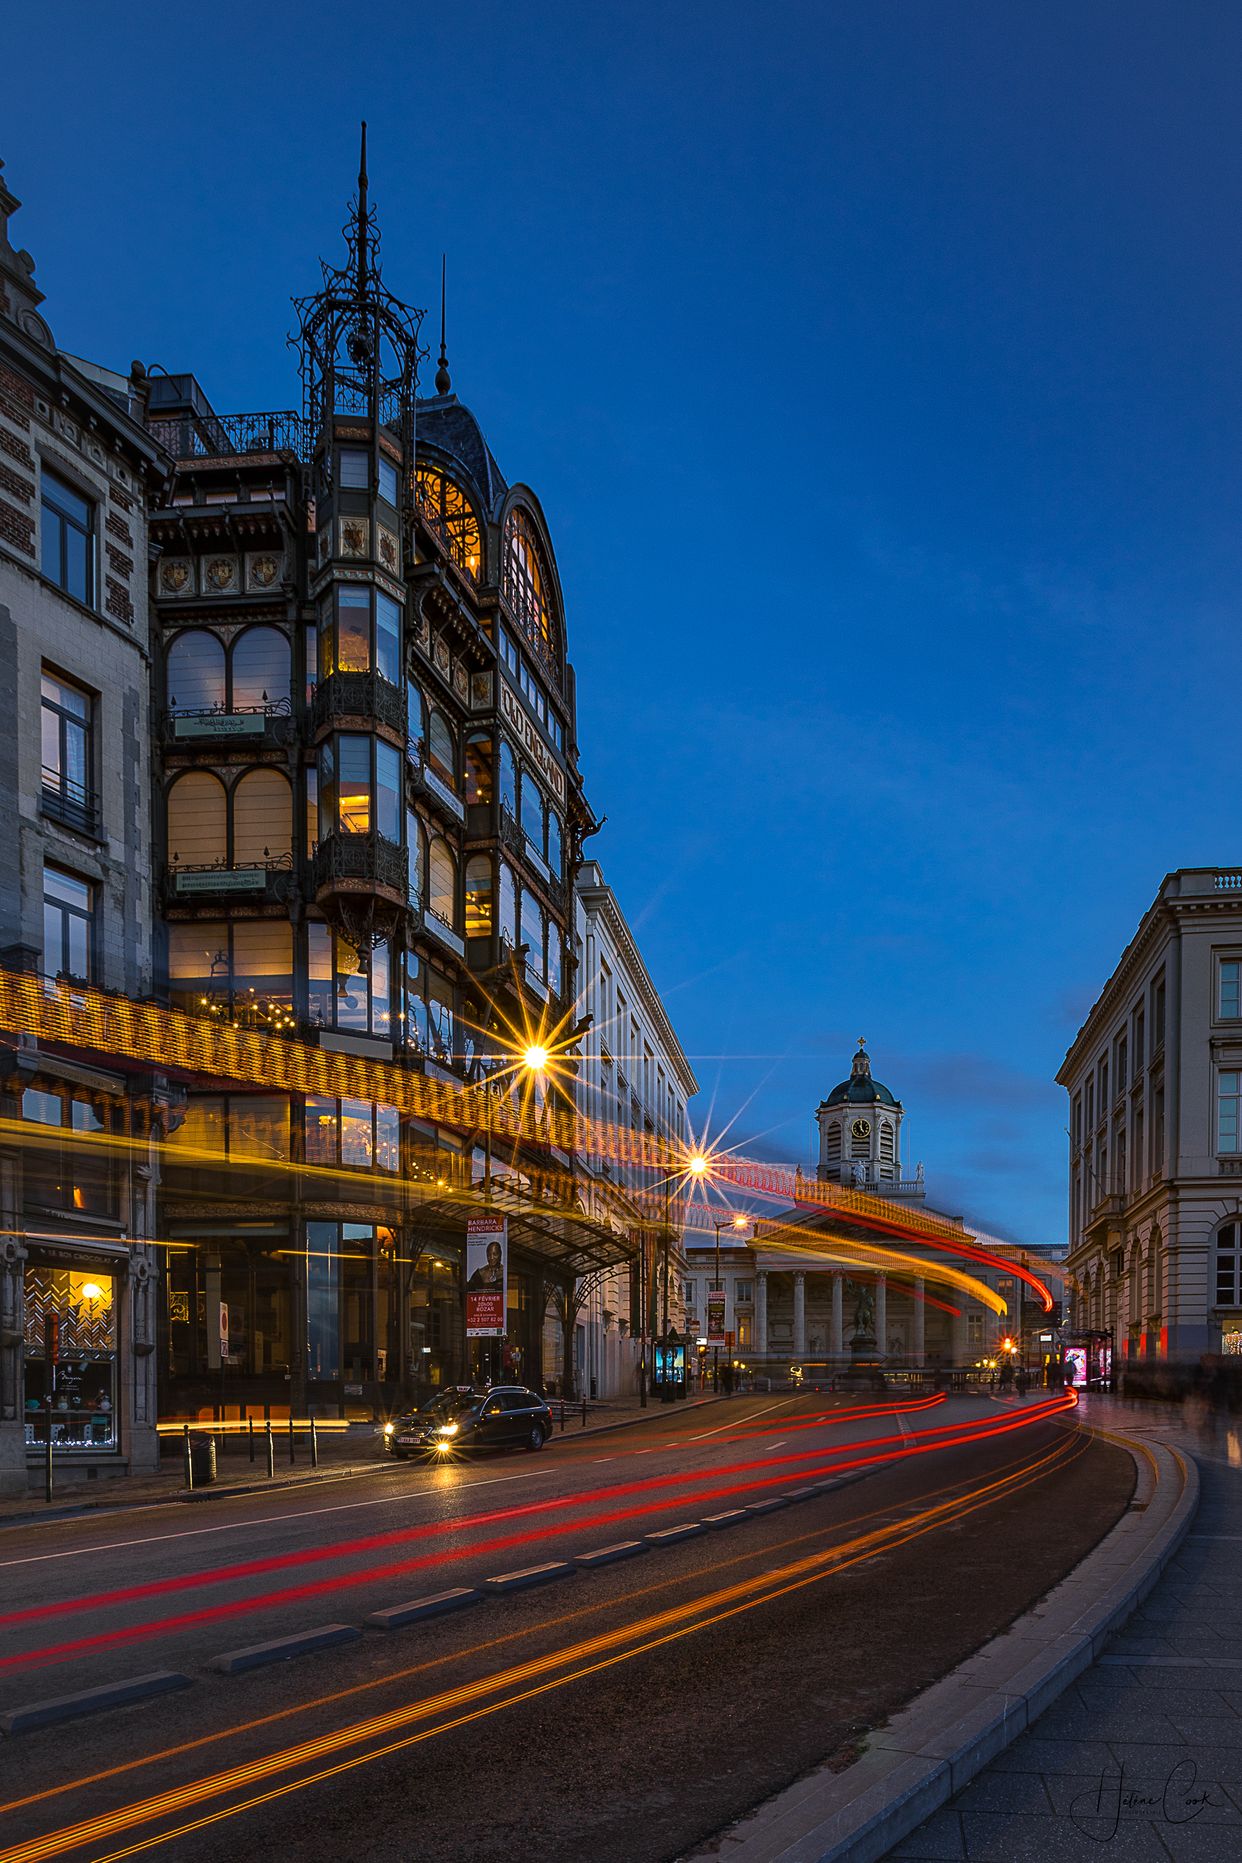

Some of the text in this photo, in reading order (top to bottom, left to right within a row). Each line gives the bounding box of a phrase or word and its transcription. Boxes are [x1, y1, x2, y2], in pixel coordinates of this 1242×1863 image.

[504, 690, 563, 795] OLD ENGLAND
[467, 1225, 503, 1233] HENDRICKS
